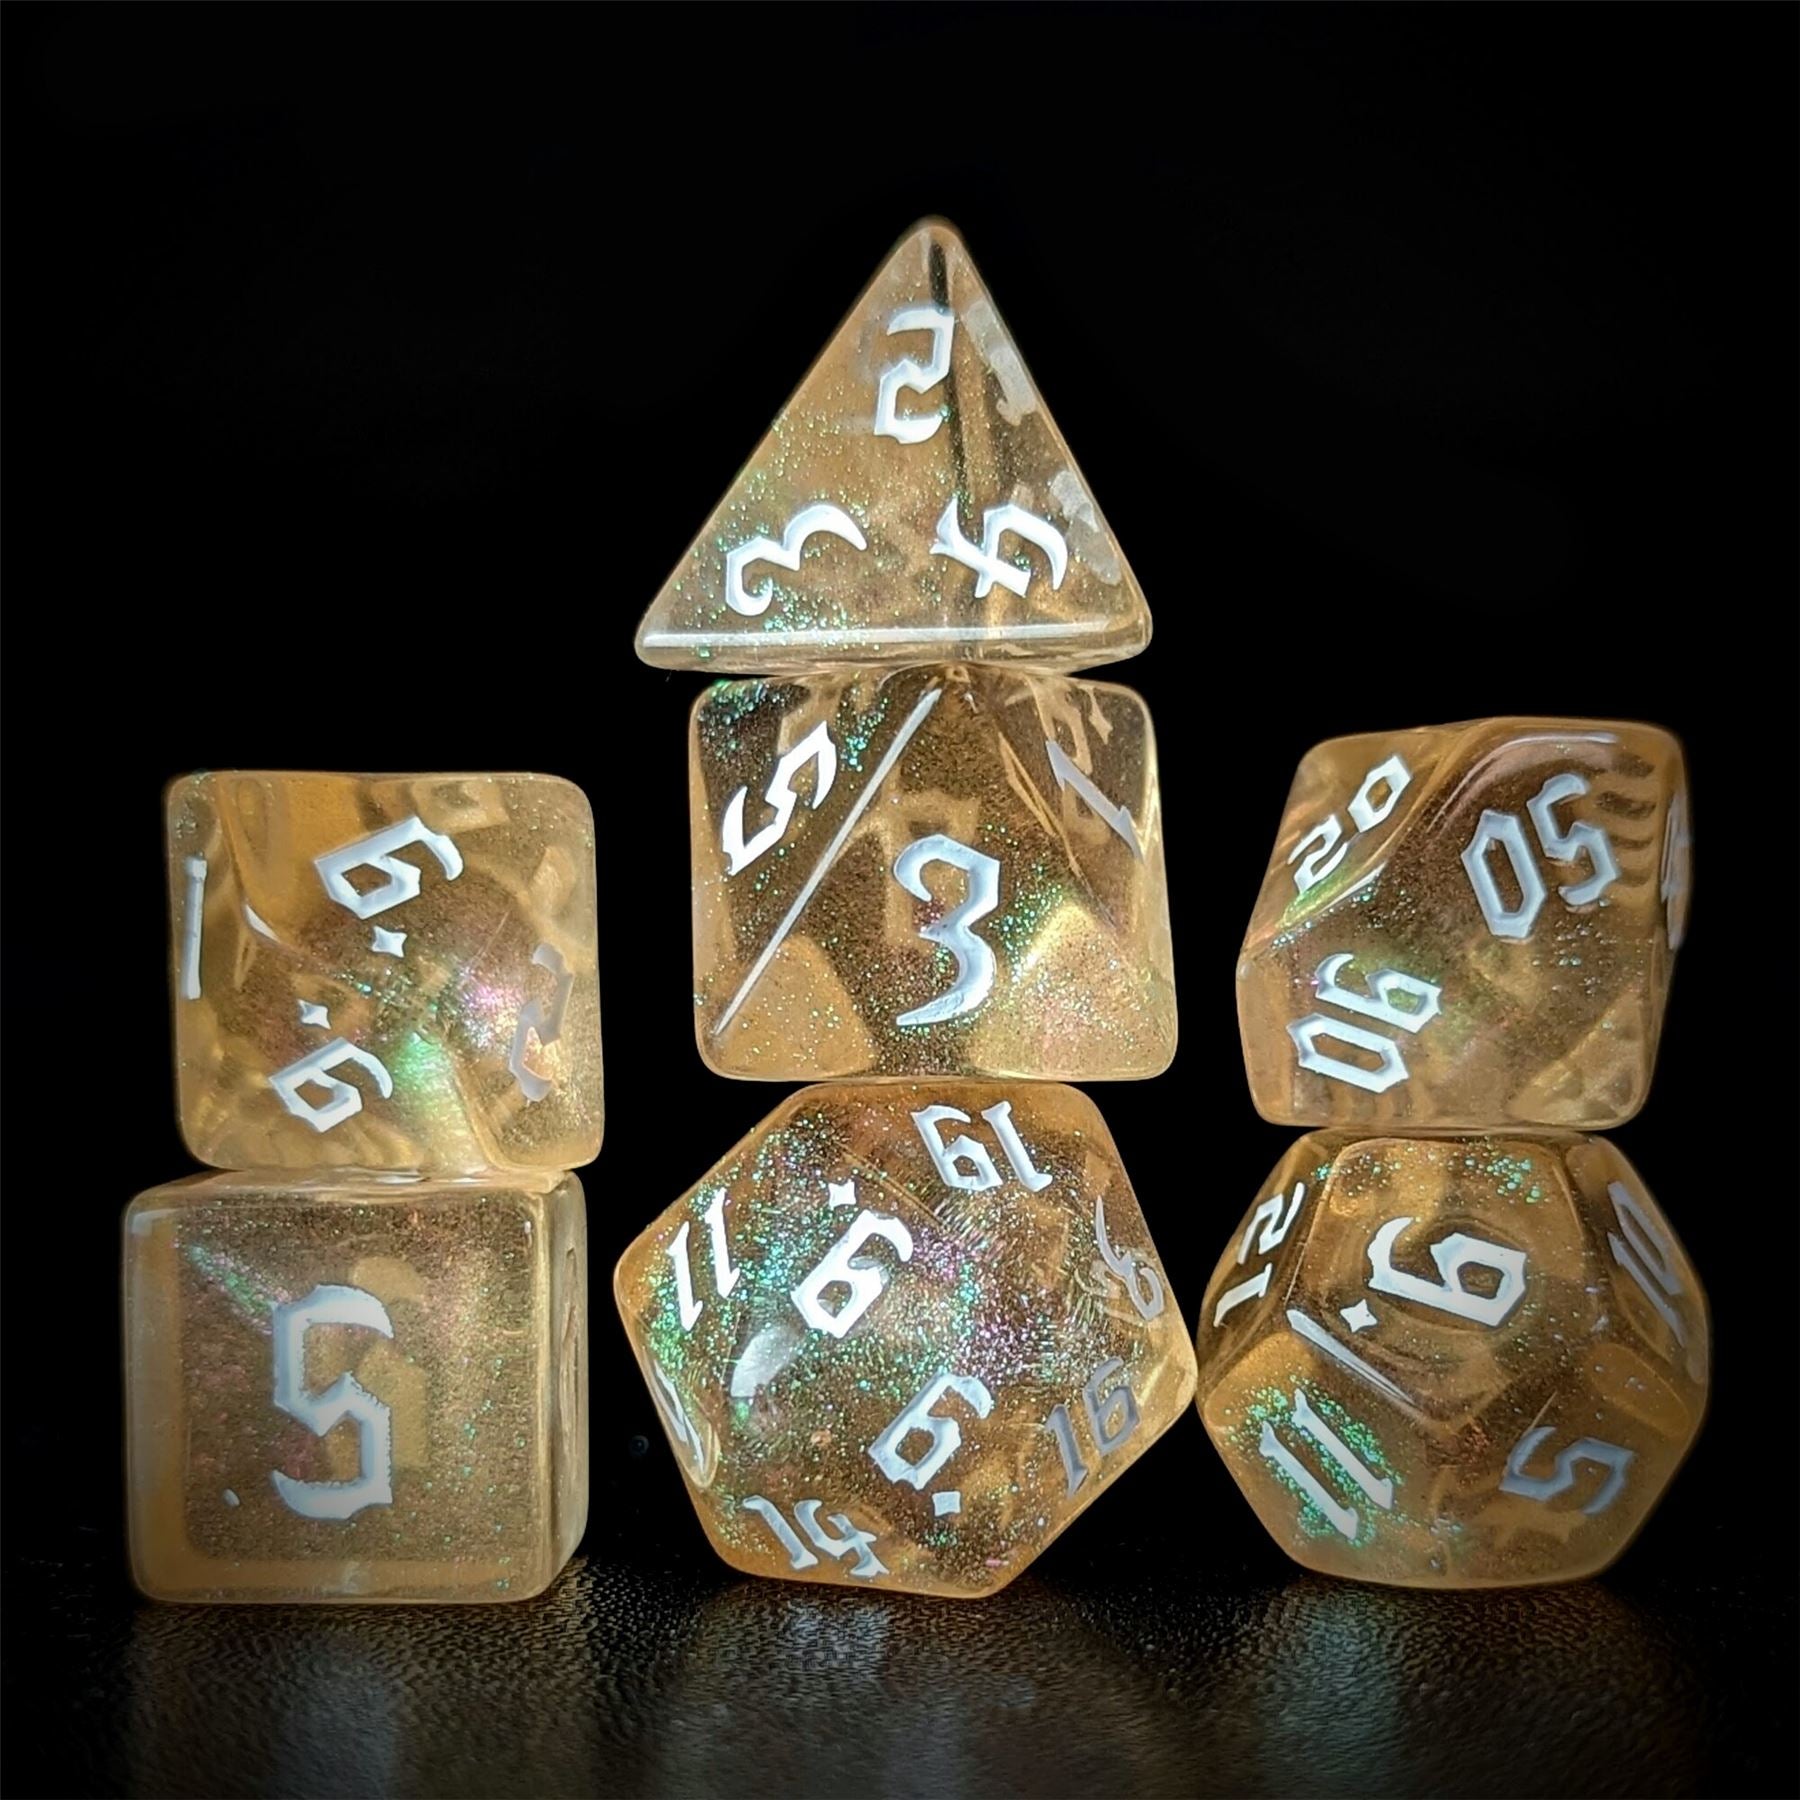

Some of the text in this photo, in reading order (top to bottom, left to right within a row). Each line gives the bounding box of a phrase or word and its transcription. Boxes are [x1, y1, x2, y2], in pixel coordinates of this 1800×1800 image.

[874, 305, 955, 444] 2
[725, 505, 867, 616] 3
[930, 497, 1067, 598] 4
[722, 721, 837, 876] 5
[1288, 755, 1413, 895] 20
[893, 834, 1001, 1026] 3
[667, 1188, 740, 1332] 11
[1213, 1181, 1305, 1328] 12
[272, 1284, 394, 1521] 5
[1044, 1357, 1141, 1498] 16
[1261, 1389, 1393, 1540] 11
[744, 1495, 889, 1577] 14
